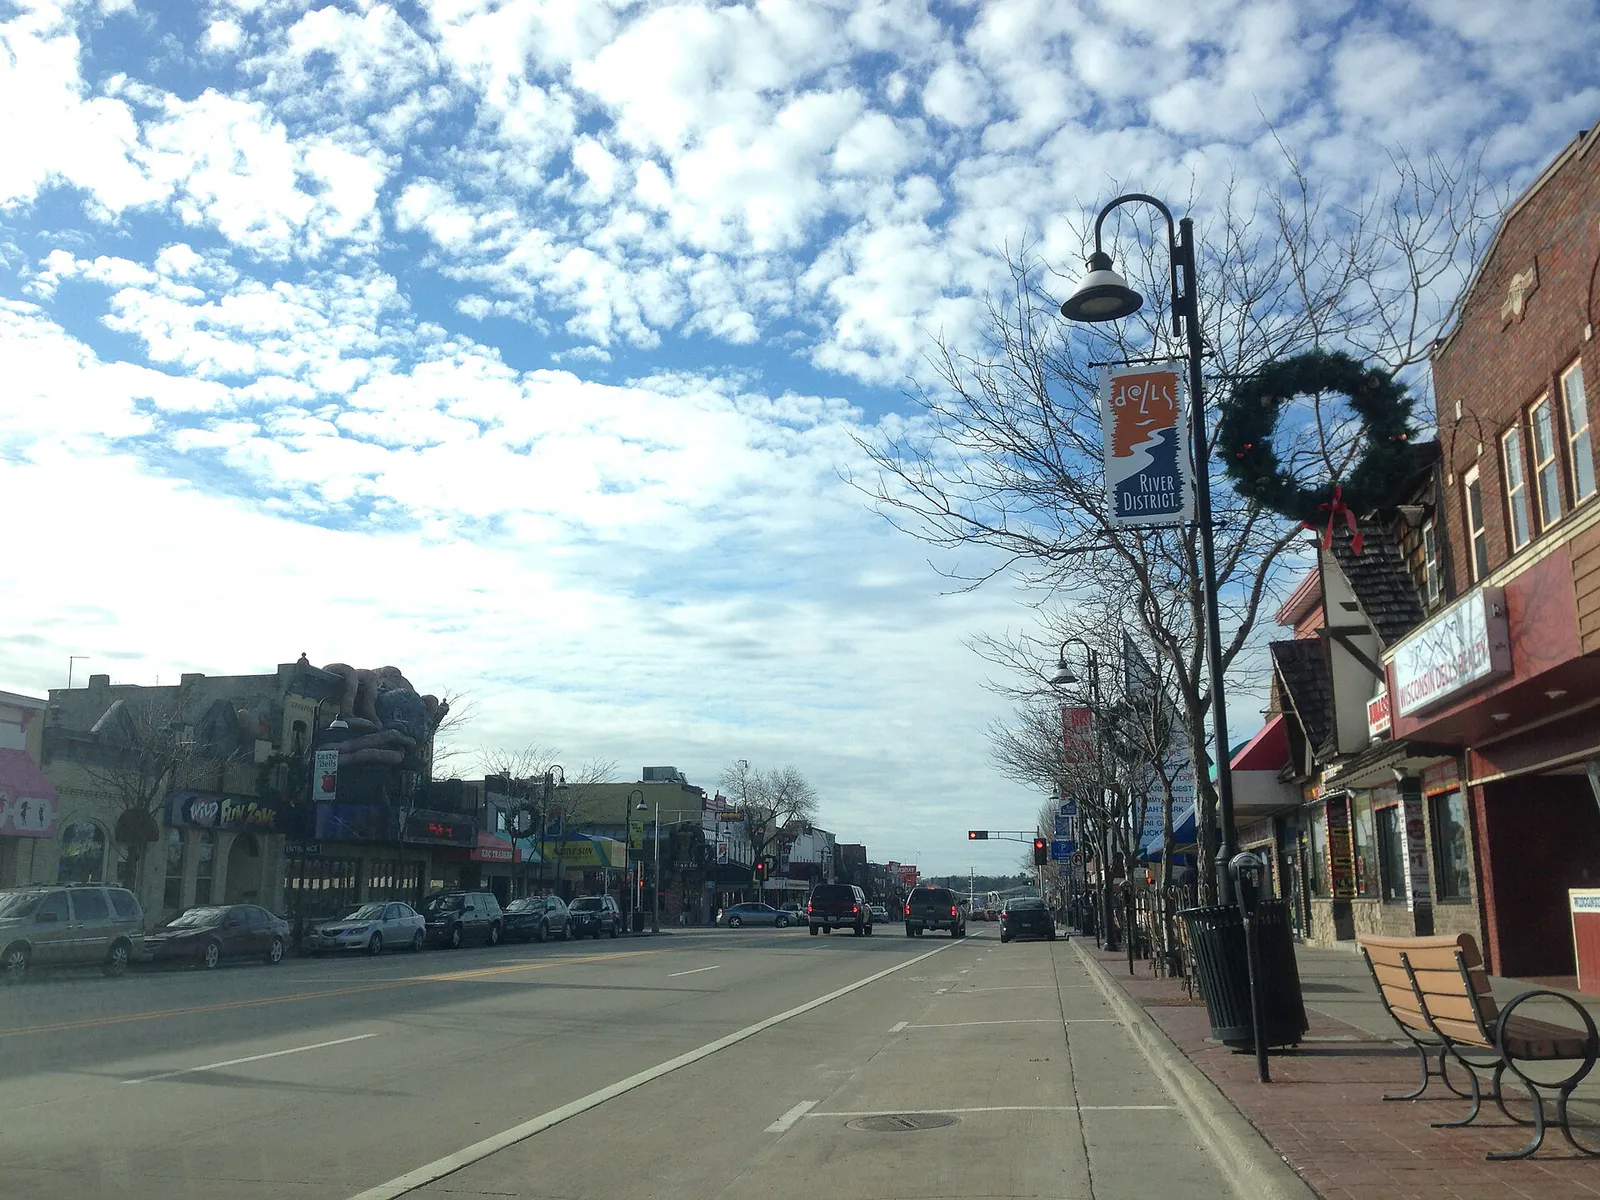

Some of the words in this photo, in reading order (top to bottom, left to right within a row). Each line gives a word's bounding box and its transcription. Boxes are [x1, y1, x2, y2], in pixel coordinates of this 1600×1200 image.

[1139, 473, 1175, 493] RIVER
[1400, 669, 1435, 708] WISCONSIN
[220, 799, 245, 823] FUN
[285, 845, 318, 853] ENTRNCE
